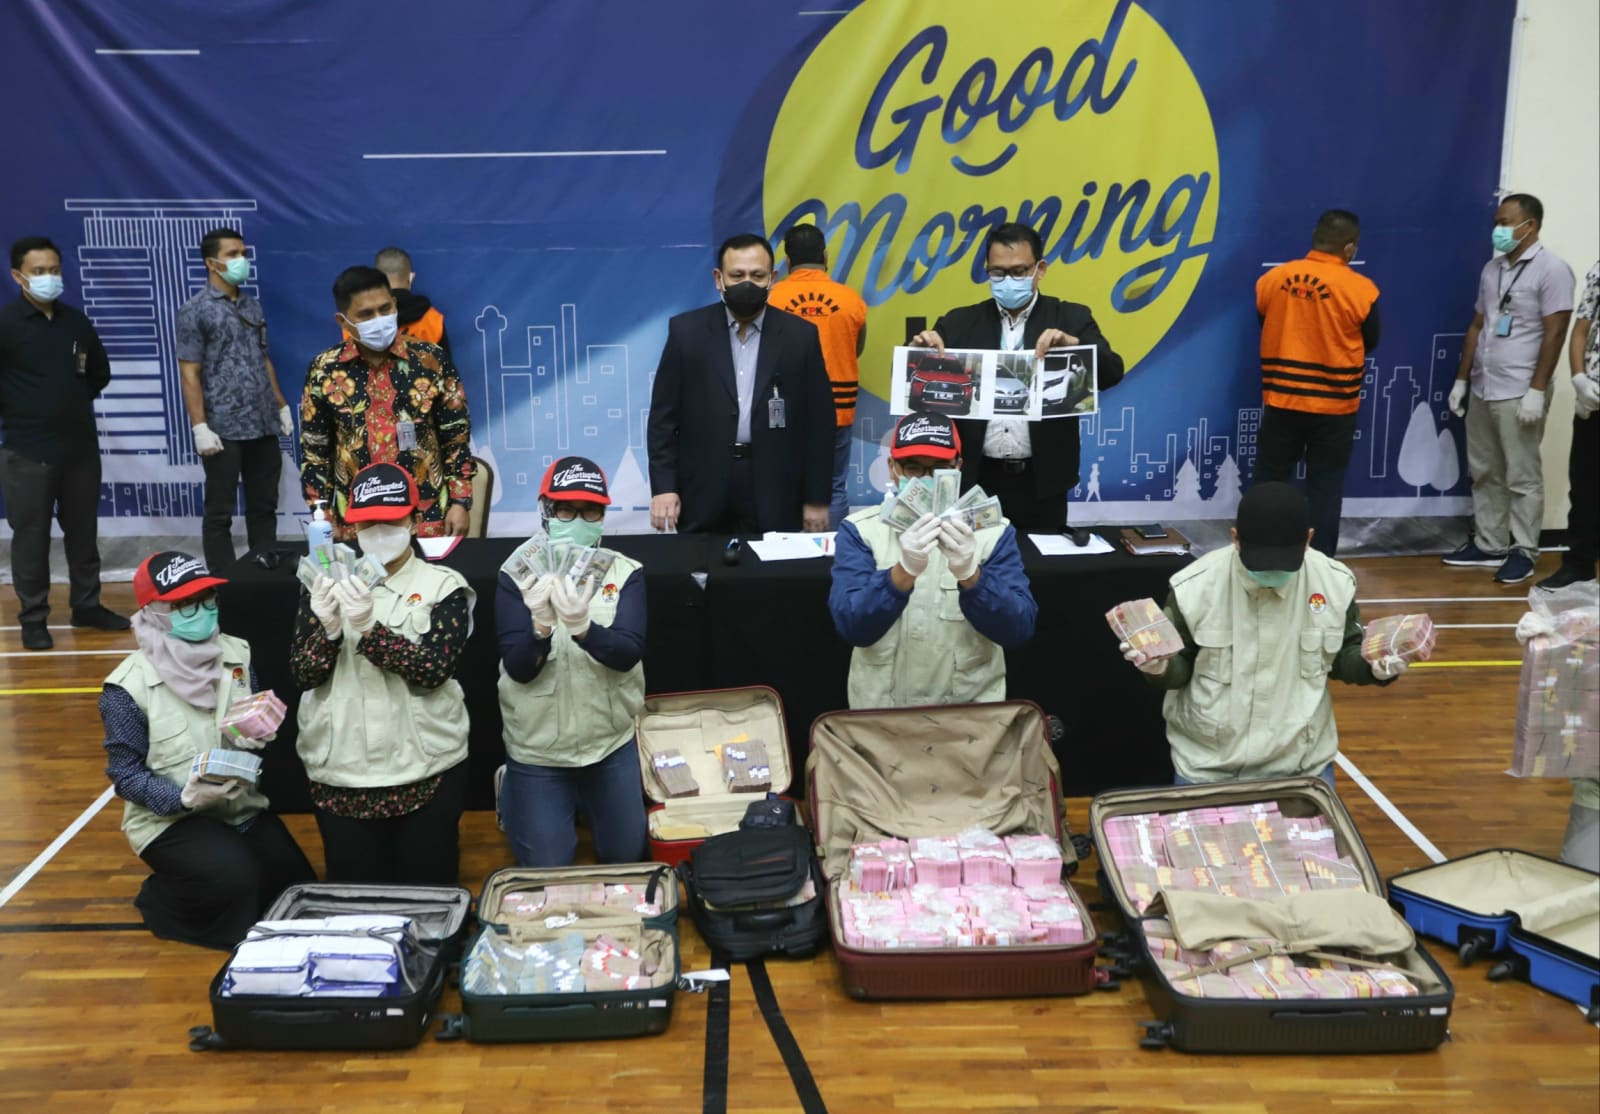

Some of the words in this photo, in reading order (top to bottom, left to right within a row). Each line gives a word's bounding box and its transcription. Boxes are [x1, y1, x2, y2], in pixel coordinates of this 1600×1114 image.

[855, 0, 1138, 175] Good
[768, 171, 1212, 313] Morning
[1291, 287, 1313, 297] KPK
[785, 292, 840, 312] TAHANAN
[916, 417, 929, 428] The
[569, 464, 584, 475] The
[366, 476, 381, 487] The
[353, 481, 406, 503] Uncorrupted
